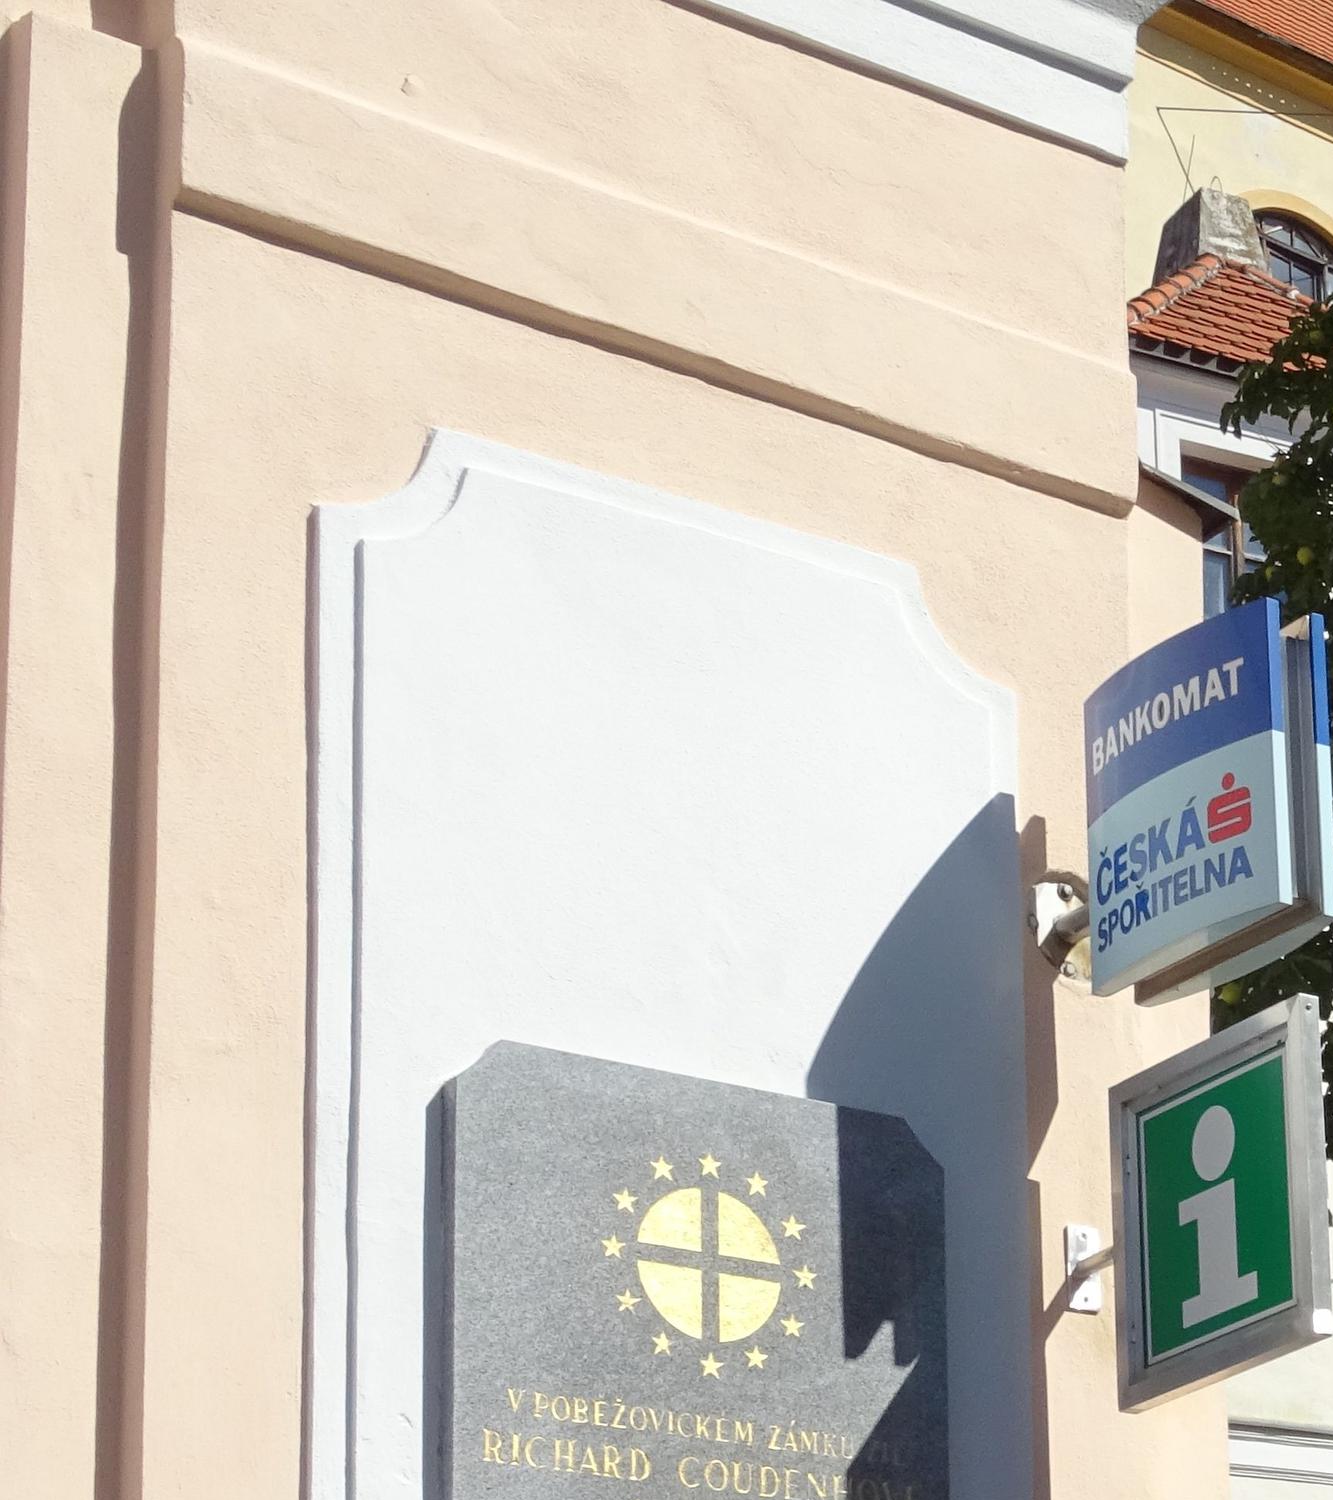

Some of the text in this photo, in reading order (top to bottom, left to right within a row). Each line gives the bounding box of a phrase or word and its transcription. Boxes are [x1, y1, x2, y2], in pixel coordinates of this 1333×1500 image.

[1092, 656, 1244, 776] BANKOMAT
[1096, 796, 1206, 906] ČESKÁ
[1097, 845, 1254, 953] SPOŘITELNA
[482, 1428, 651, 1481] RICHARD
[507, 1387, 526, 1413] V
[767, 1420, 855, 1460] ZÁMKU
